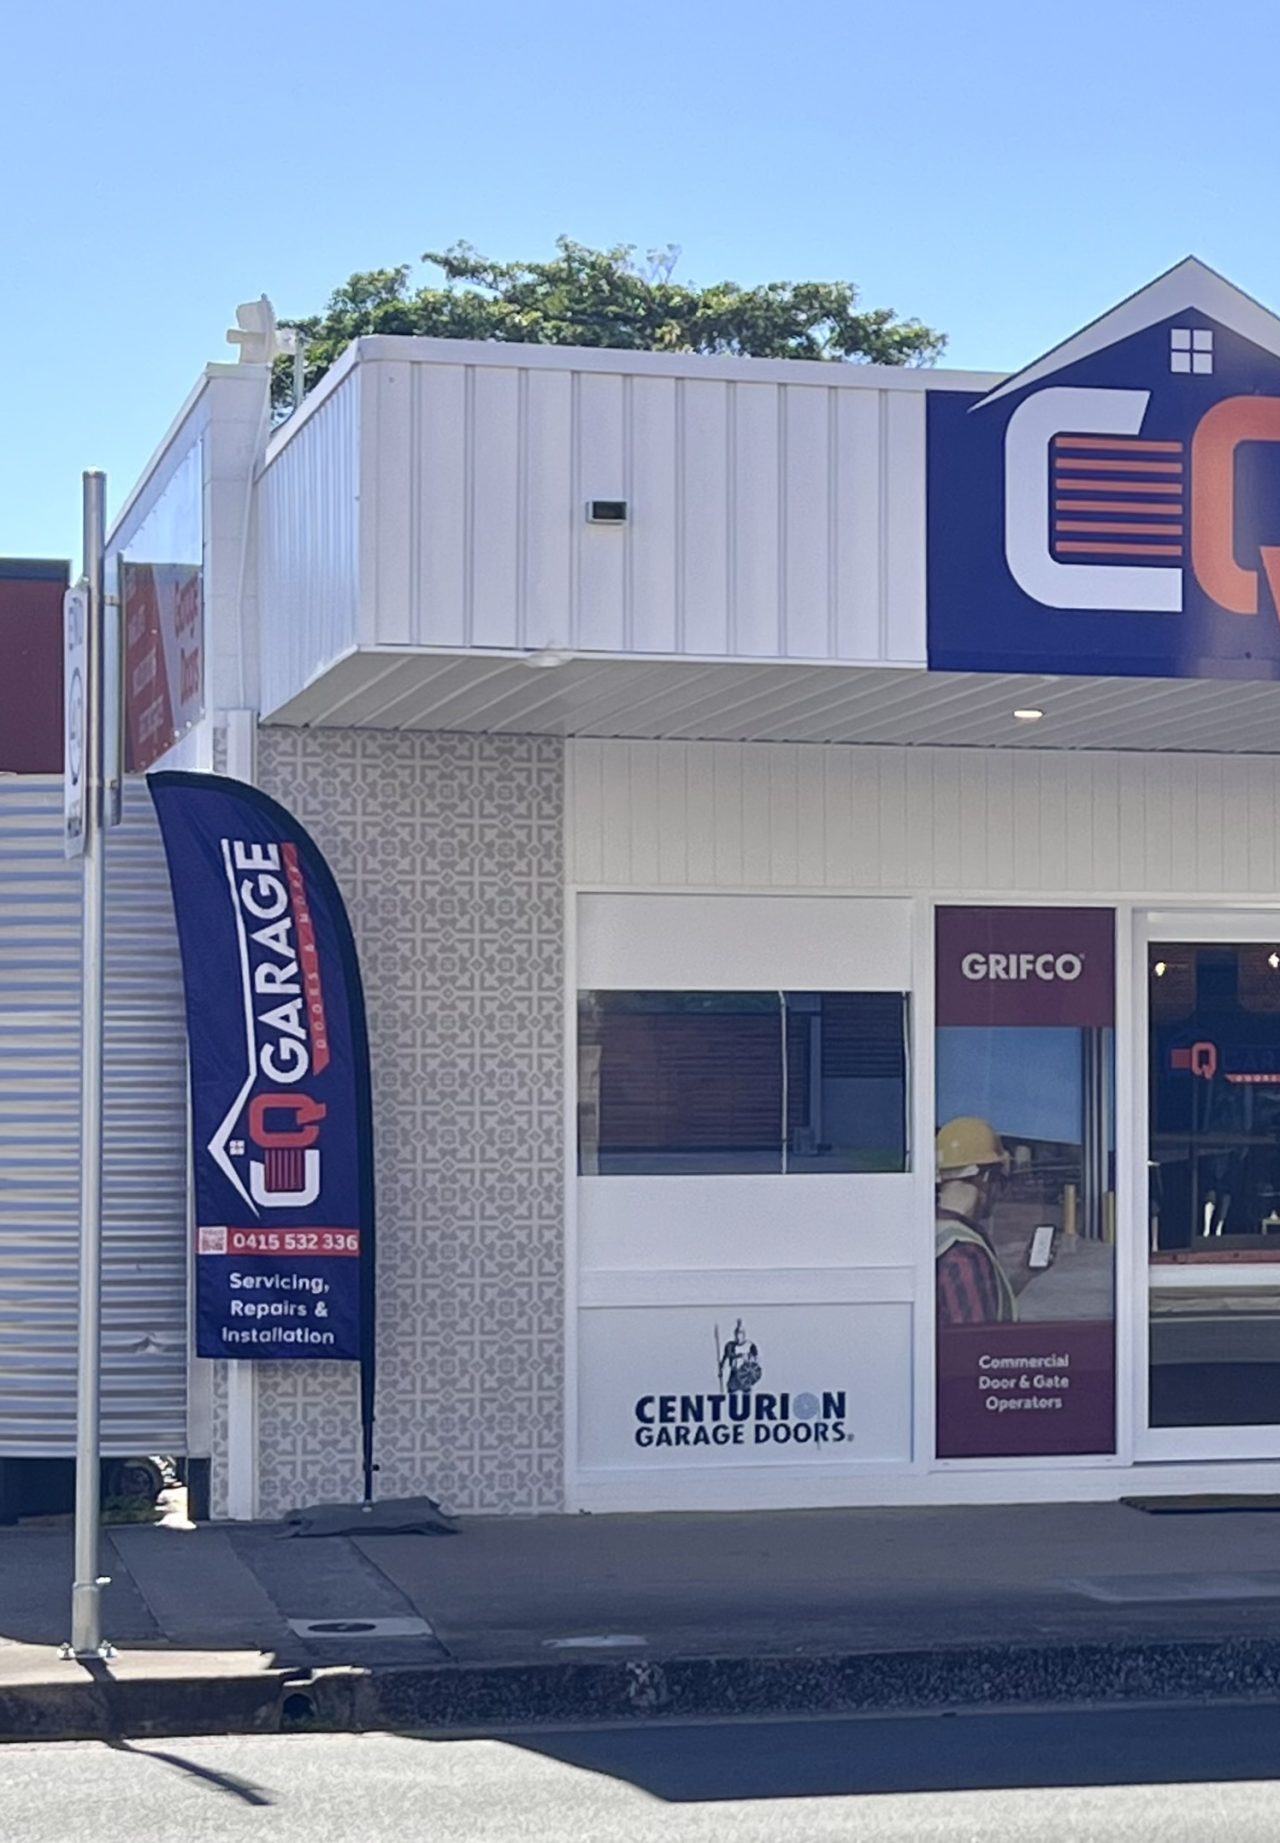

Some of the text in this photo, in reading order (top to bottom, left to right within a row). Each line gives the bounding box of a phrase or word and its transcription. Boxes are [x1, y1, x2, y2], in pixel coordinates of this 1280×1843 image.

[233, 840, 309, 1084] GARAGE
[961, 952, 1083, 981] GRIFCO
[232, 1233, 359, 1250] 0415 532 336
[229, 1272, 331, 1294] Servicing,
[230, 1300, 329, 1319] Repairs &
[221, 1327, 335, 1345] Installation
[978, 1353, 1070, 1369] Commercial
[978, 1374, 1070, 1390] Door & Gate
[635, 1391, 846, 1424] CENTURION
[985, 1395, 1063, 1413] Operators
[635, 1423, 745, 1447] GARAGE
